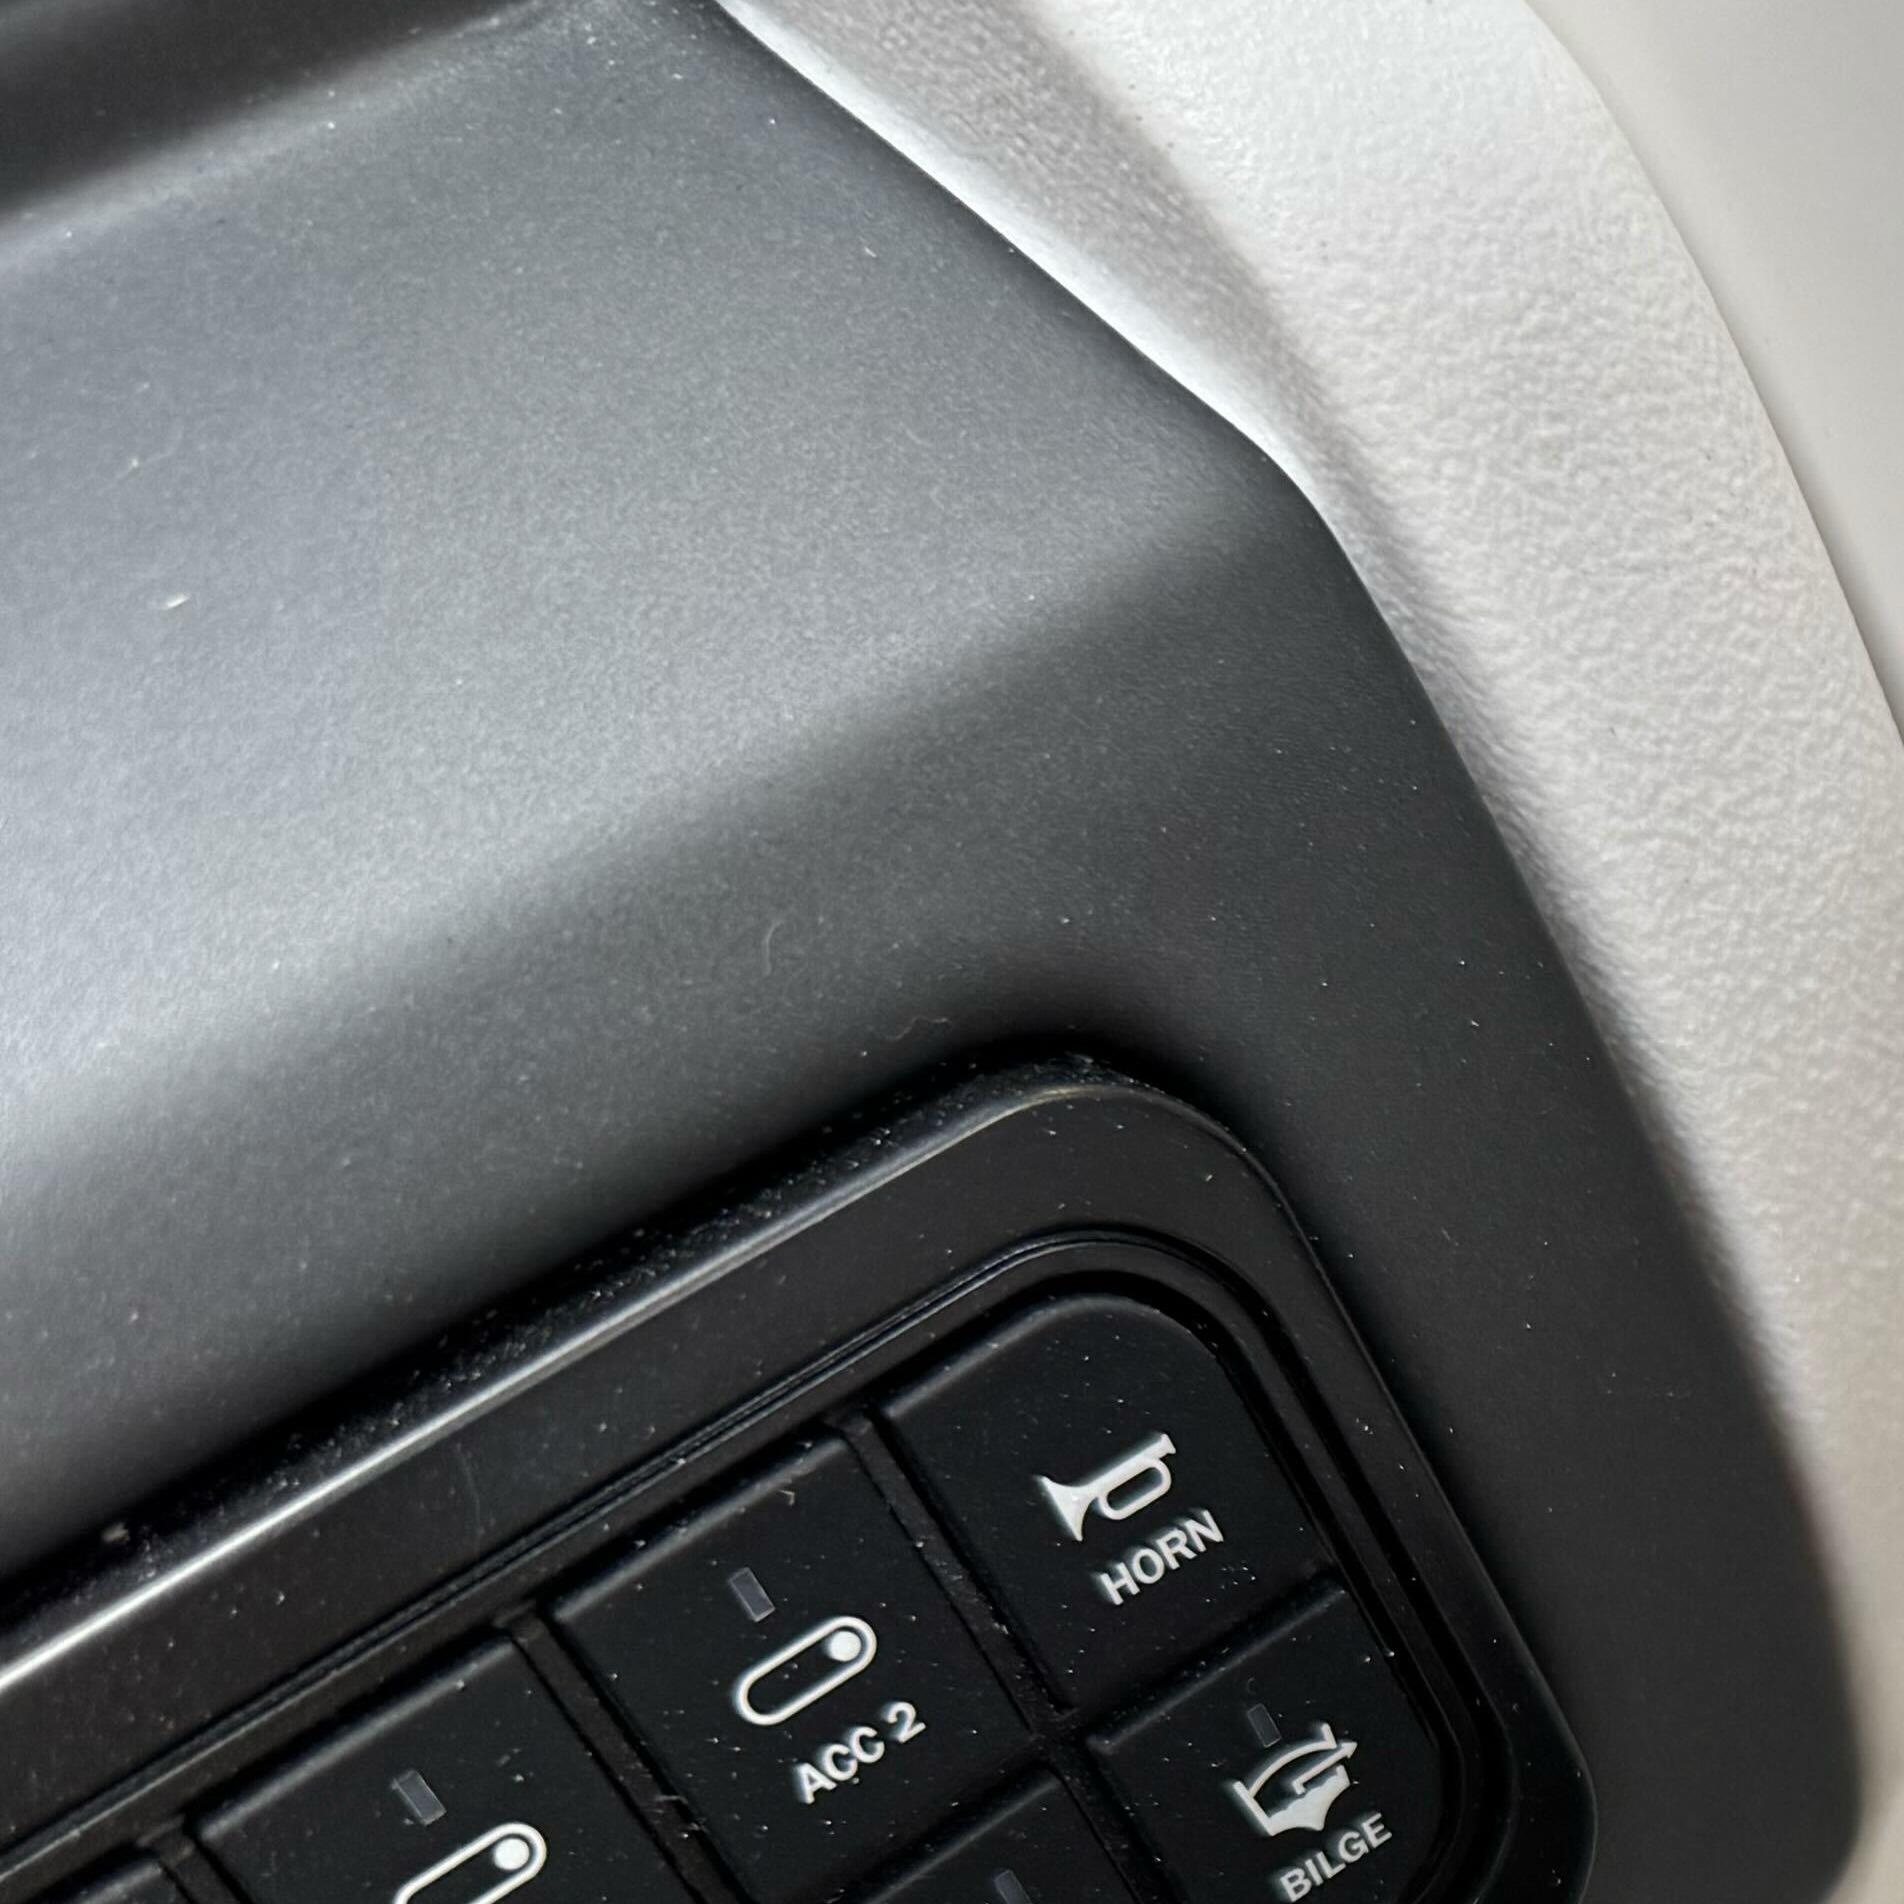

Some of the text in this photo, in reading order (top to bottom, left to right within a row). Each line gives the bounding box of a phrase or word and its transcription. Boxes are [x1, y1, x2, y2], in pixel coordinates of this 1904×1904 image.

[1098, 1509, 1224, 1606] HORN
[799, 1700, 926, 1805] ACC 2
[1279, 1811, 1393, 1904] BILGE
